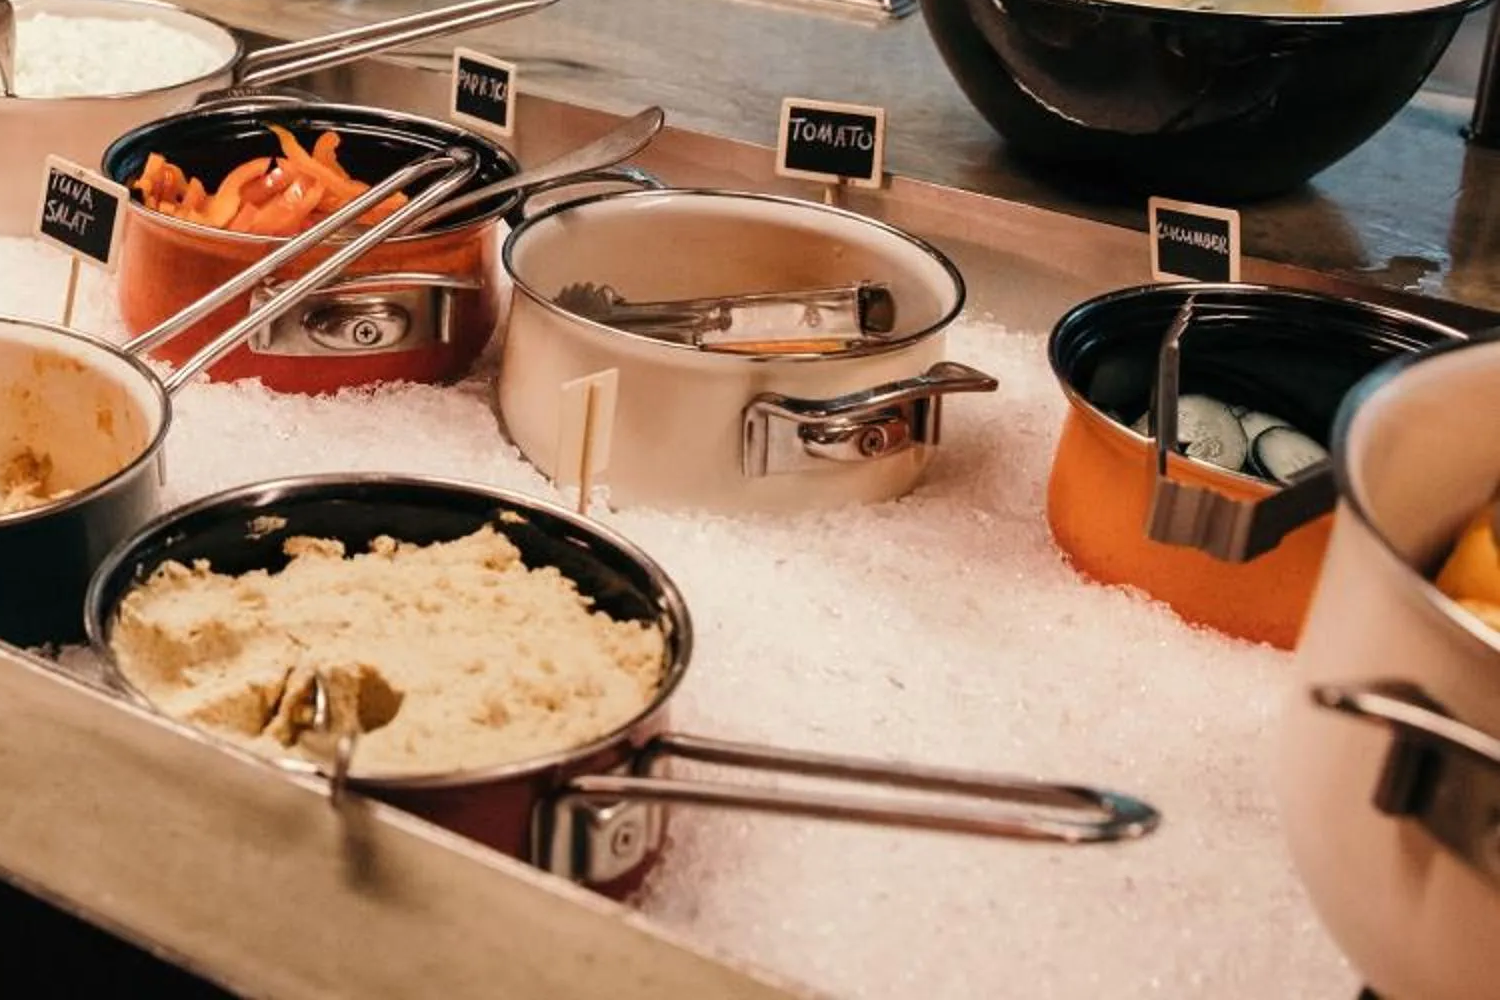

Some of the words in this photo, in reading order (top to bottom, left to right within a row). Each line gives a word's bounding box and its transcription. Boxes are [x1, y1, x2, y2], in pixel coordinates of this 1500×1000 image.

[789, 117, 873, 150] TOMATO
[51, 168, 93, 211] TUNA
[45, 199, 96, 236] SALAT
